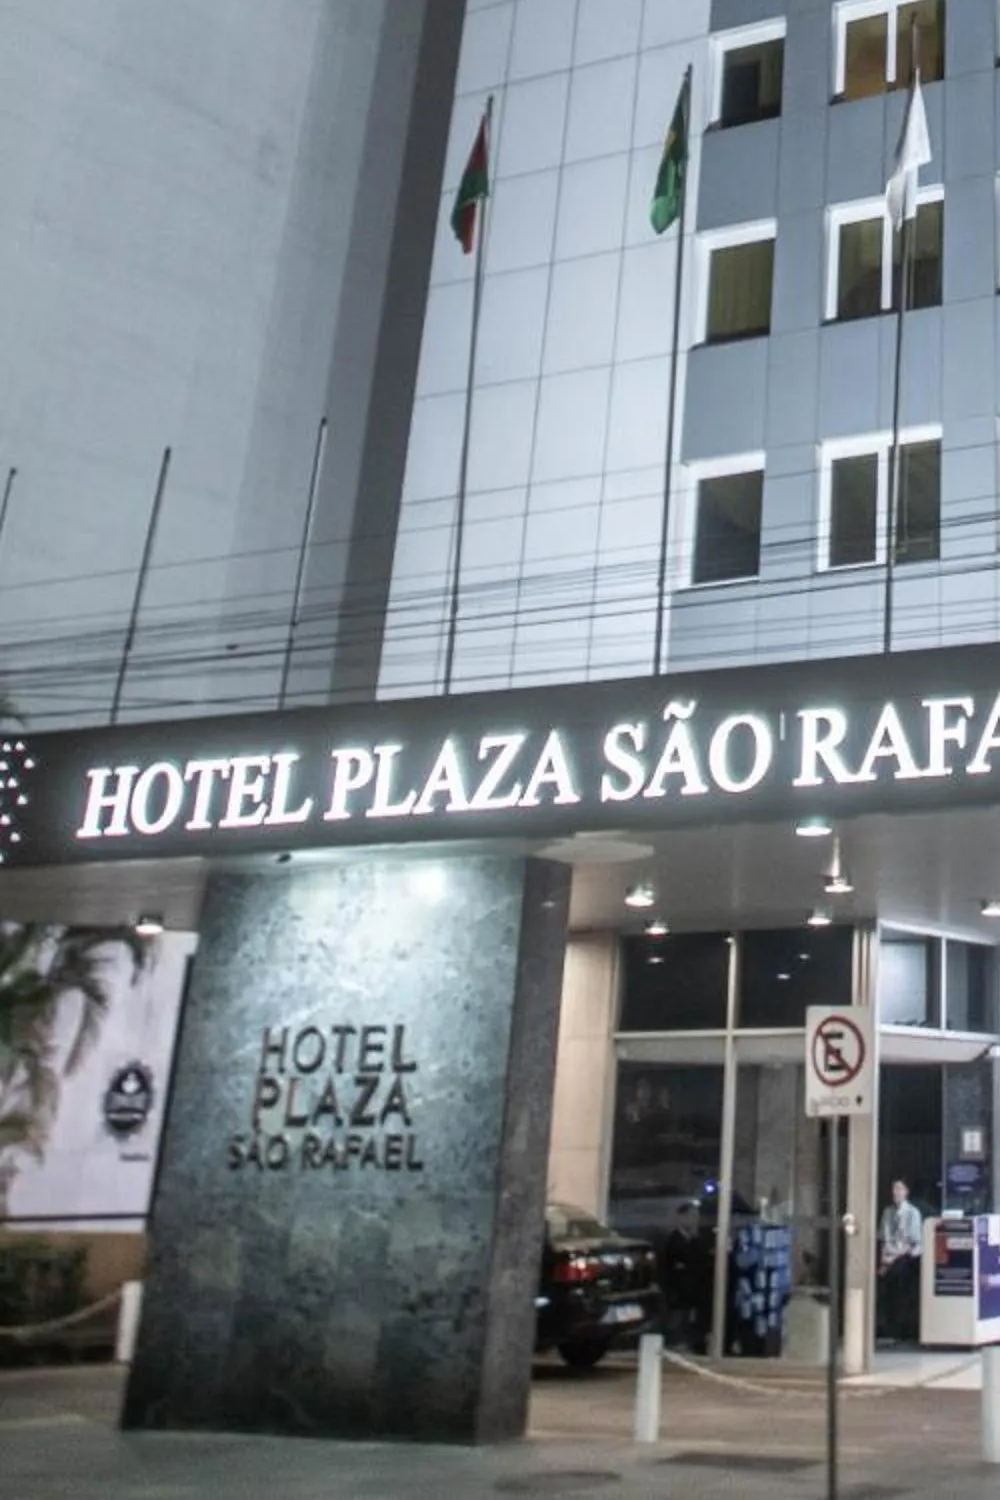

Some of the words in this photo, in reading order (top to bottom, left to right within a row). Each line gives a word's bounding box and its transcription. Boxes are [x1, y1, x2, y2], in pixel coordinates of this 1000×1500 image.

[76, 750, 313, 838] HOTEL
[323, 730, 580, 820] PLAZA
[600, 700, 775, 801] SÃO
[259, 1025, 418, 1074] HOTEL
[252, 1075, 412, 1129] PLAZA
[301, 1133, 423, 1171] RAFAEL
